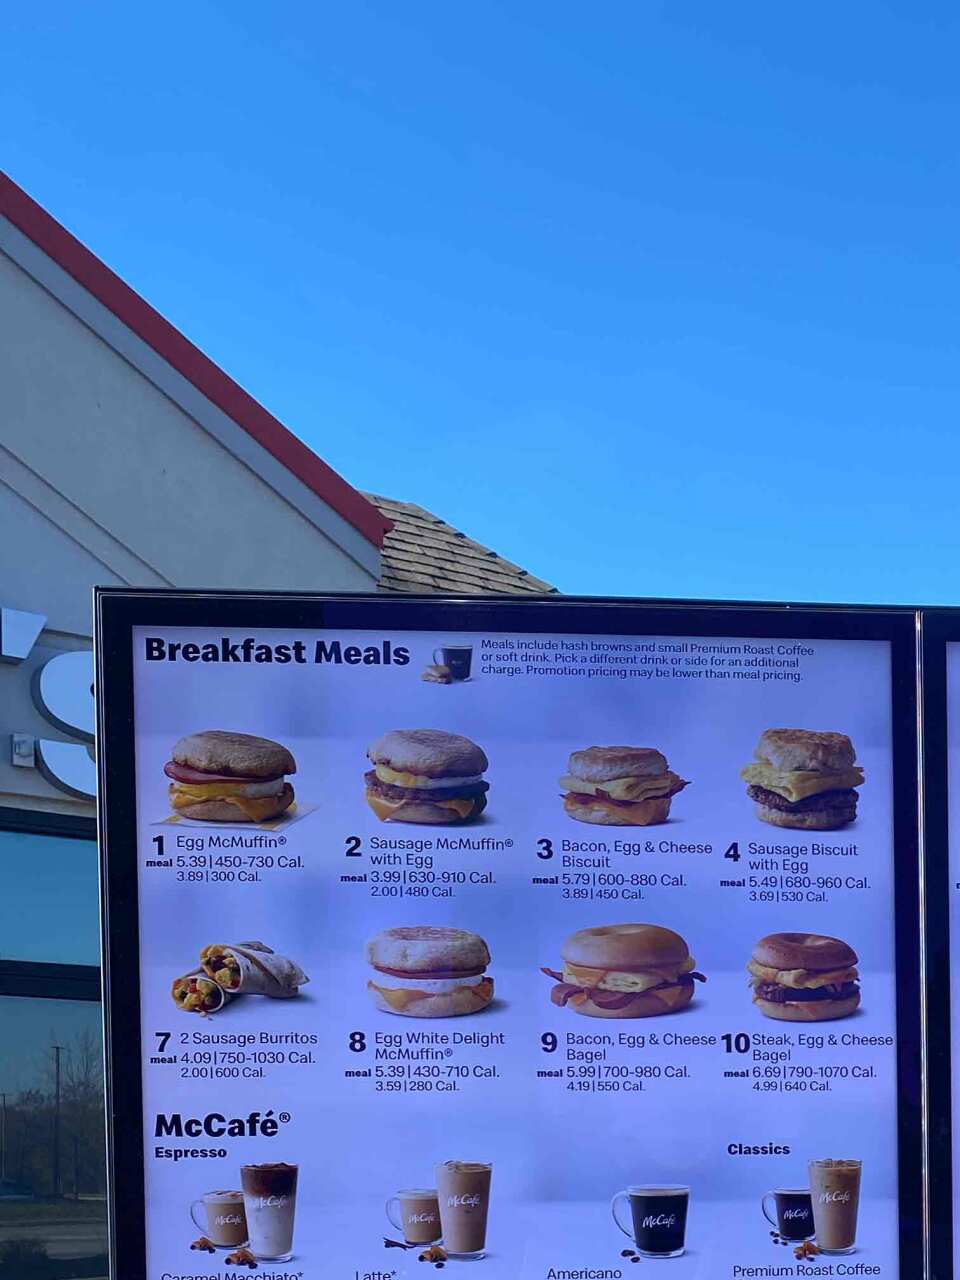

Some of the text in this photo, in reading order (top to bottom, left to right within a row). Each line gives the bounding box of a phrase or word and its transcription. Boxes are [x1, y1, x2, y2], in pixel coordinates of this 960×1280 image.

[145, 637, 410, 666] Breakfast Meals
[480, 638, 814, 656] Meals include hash browns and small Premium Roast Coffee
[152, 835, 164, 856] 1
[176, 835, 204, 851] Egg
[345, 835, 362, 857] 2
[536, 838, 554, 860] 3
[561, 839, 713, 856] Bacon, Egg & Cheese
[370, 852, 433, 869] with Egg
[562, 855, 611, 868] Biscuit
[154, 1031, 171, 1053] 7
[180, 1031, 318, 1048] 2 Sausage Burritos
[348, 1031, 366, 1053] 8
[540, 1031, 558, 1053] 9
[566, 1032, 717, 1049] Bacon, Egg & Cheese
[720, 1032, 750, 1054] 10
[566, 1047, 606, 1064] Bagel
[154, 1146, 227, 1162] Espresso
[727, 1142, 791, 1155] Classics
[546, 1267, 622, 1280] Americano
[733, 1262, 881, 1278] Premium Roast Coffee
